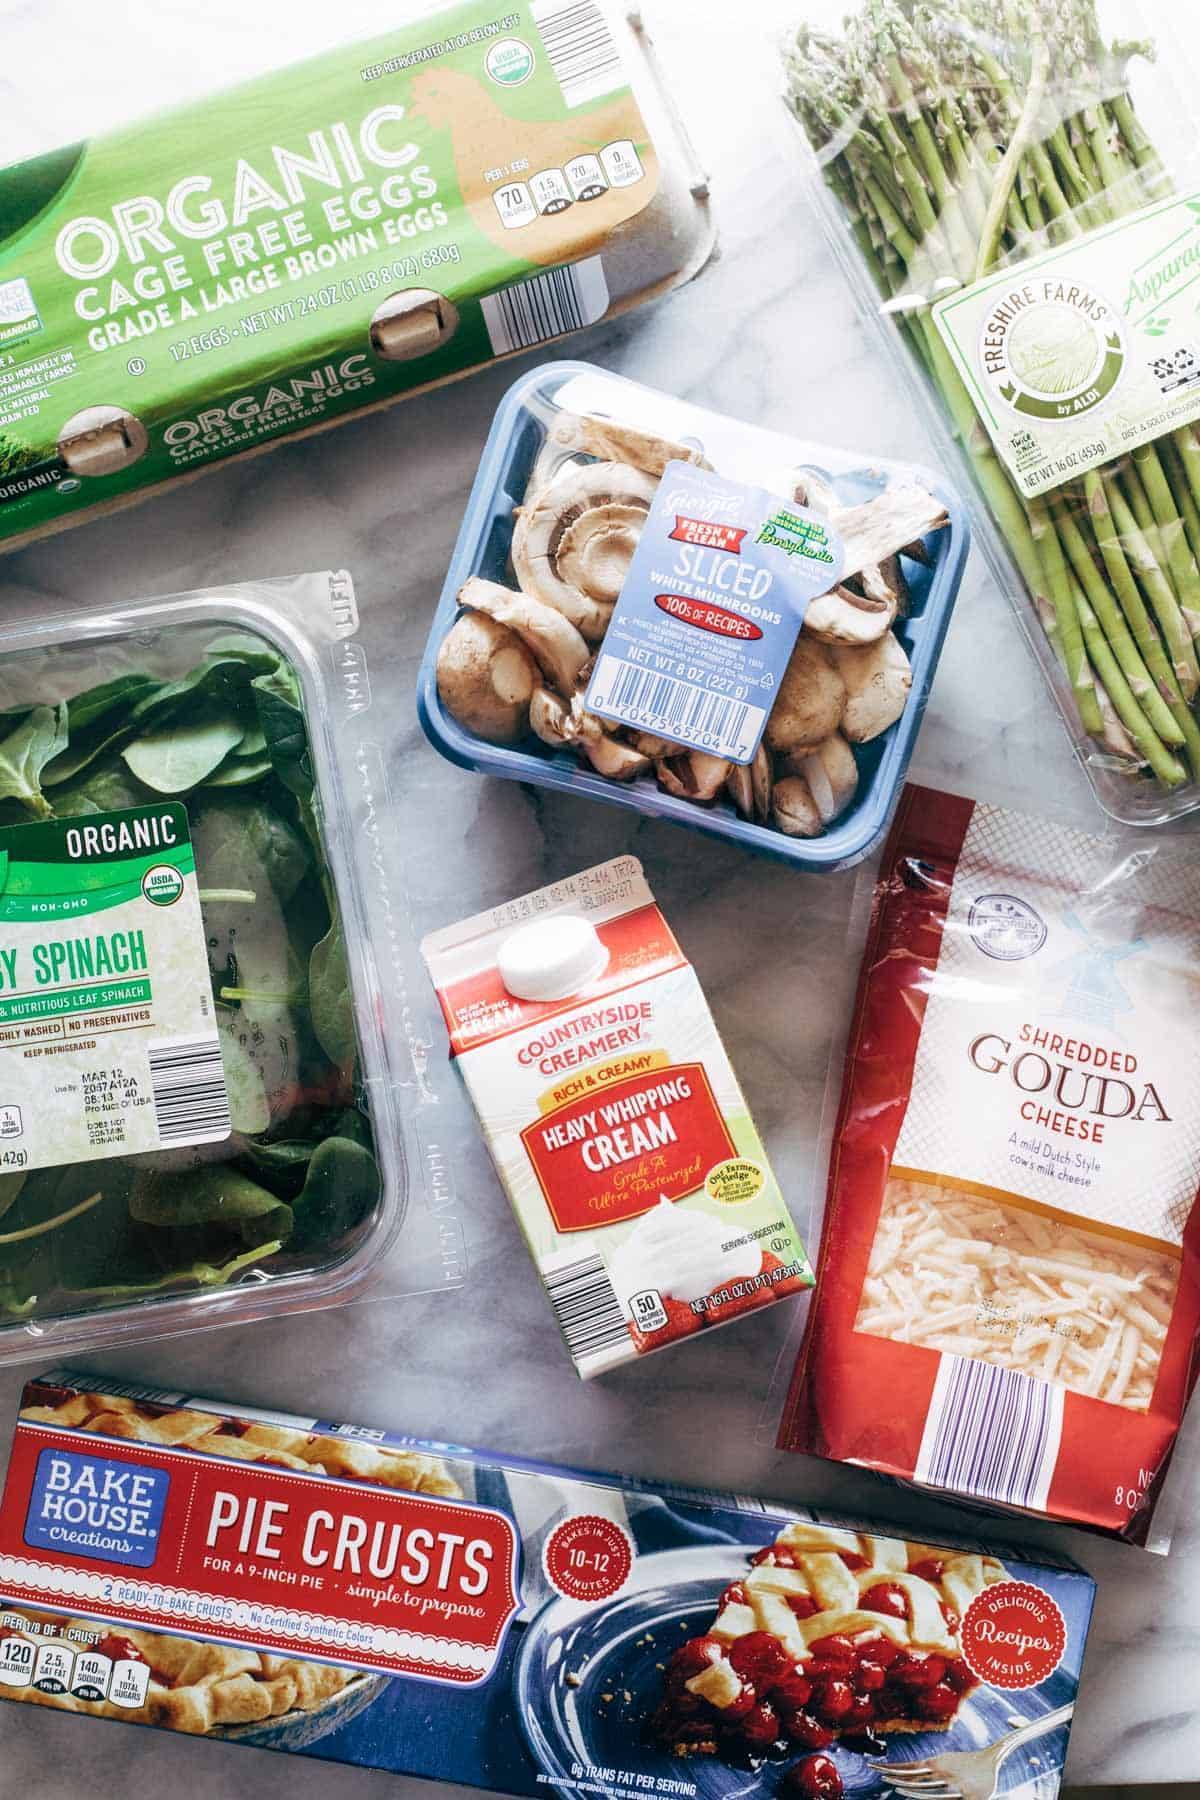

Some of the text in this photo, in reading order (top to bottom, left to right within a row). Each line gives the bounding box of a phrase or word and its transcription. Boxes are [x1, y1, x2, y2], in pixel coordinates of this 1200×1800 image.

[360, 63, 384, 82] KEEP
[384, 43, 444, 74] REFRIGERATED
[456, 33, 470, 49] OR
[469, 22, 500, 42] BELOW
[55, 104, 420, 280] ORGANIC
[501, 188, 522, 208] 70
[74, 255, 193, 321] CAGE
[202, 211, 313, 277] FREE
[322, 166, 437, 232] EGGS
[88, 202, 449, 352] GRADE A LARGE BROWN EGGS
[168, 243, 462, 363] 12 EGGS NET WT 24 OZ (1 LB 8 OZ) 680g
[984, 282, 1107, 374] FRESHIRE FARMS
[16, 356, 60, 379] HUMANELY
[60, 351, 73, 362] ON
[24, 405, 40, 416] FED
[163, 354, 371, 445] ORGANIC
[169, 373, 376, 457] CAGE FREE EGGS
[1057, 389, 1101, 415] by ALDI
[175, 445, 210, 465] GRADE
[222, 430, 255, 447] LARGE
[257, 413, 296, 434] BROWN
[299, 404, 326, 418] EGGS
[1024, 471, 1040, 488] NET
[1040, 464, 1055, 480] WT
[1055, 458, 1067, 473] 16
[1065, 453, 1079, 468] OZ
[1078, 439, 1107, 463] (453g)
[0, 469, 61, 498] ORGANIC
[681, 519, 722, 536] FRESH
[685, 533, 727, 549] CLEAN
[754, 521, 834, 563] Pennsylvania
[673, 545, 774, 601] SLICED
[651, 570, 783, 625] WHITE MUSHROOMS
[693, 609, 751, 638] OF RECIPES
[627, 645, 750, 700] NET WT 8 OZ (227 g)
[594, 695, 748, 758] 0 70475 65704 7
[66, 815, 177, 858] ORGANIC
[151, 874, 174, 885] USDA
[31, 898, 88, 912] NON-GMO
[33, 930, 148, 984] SPINACH
[11, 985, 144, 1015] NUTRITIOUS LEAF SPINACH
[24, 1010, 151, 1038] WASHED NO PRESERVATIVES
[517, 1001, 653, 1066] COUNTRYSIDE
[24, 1040, 97, 1058] KEEP REFRIGERATED
[538, 1022, 642, 1076] CREAMERY
[1019, 1023, 1137, 1074] SHREDDED
[81, 1068, 123, 1083] MAR 12
[553, 1055, 652, 1103] RICH & CREAMY
[967, 1032, 1174, 1122] GOUDA
[541, 1076, 692, 1152] HEAVY WHIPPING
[1020, 1101, 1105, 1144] CHEESE
[580, 1111, 679, 1173] CREAM
[1008, 1132, 1041, 1154] A mild
[588, 1189, 629, 1212] Ultra
[631, 1156, 702, 1195] Pasteurized
[613, 1156, 668, 1189] Grade A
[709, 1164, 761, 1185] Our Farmers
[720, 1172, 750, 1185] Pledge
[1009, 1153, 1092, 1186] cow's milk cheese
[721, 1220, 786, 1253] SERVING SUGGESTION
[637, 1295, 656, 1314] 50
[690, 1261, 804, 1315] NET 16 FL OZ (1 PT) 473mL
[638, 1310, 664, 1323] CALORIES
[46, 1460, 156, 1508] BAKE
[1115, 1486, 1124, 1505] 8
[205, 1490, 494, 1597] PIE CRUSTS
[561, 1527, 621, 1558] BAKES IN JUST
[203, 1556, 324, 1590] FOR A 9-INCH PIE
[569, 1548, 611, 1573] 10-12
[561, 1569, 611, 1591] MINUTES
[104, 1583, 233, 1619] 2 READY-TO-BAKE CRUSTS
[345, 1580, 487, 1620] simple to prepare
[988, 1596, 1049, 1624] DELICIOUS
[4, 1615, 101, 1646] PER 1/8 OF 1 CRUST
[250, 1611, 375, 1645] No Certified Synthetic Colors
[974, 1619, 1054, 1656] Recipes
[0, 1661, 31, 1675] CALORIES
[5, 1643, 31, 1664] 120
[985, 1655, 1033, 1675] INSIDE
[40, 1665, 67, 1678] SAT FAT
[77, 1672, 105, 1686] SODIUM
[119, 1680, 139, 1692] TOTAL
[114, 1688, 141, 1701] SUGARS
[571, 1762, 698, 1797] 0g TRANS FAT PER SERVING
